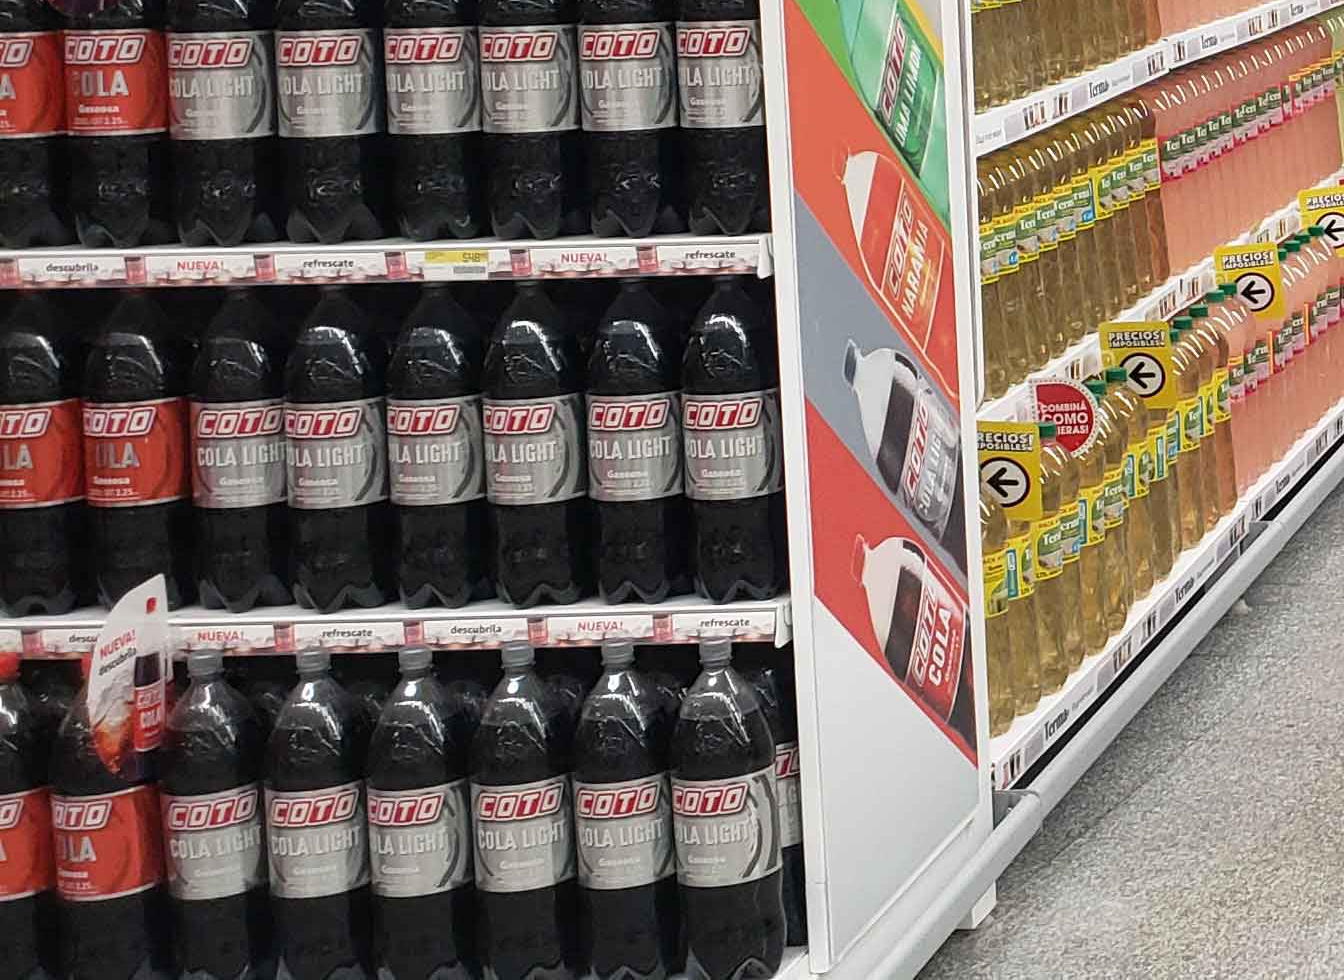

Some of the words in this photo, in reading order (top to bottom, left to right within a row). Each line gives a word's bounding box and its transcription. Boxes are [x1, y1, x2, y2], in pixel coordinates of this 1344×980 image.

[64, 34, 148, 65] COTO
[168, 37, 254, 68] COTO
[279, 35, 364, 66] COTO
[581, 28, 660, 60] COTO
[619, 65, 663, 90] LIGHT
[879, 24, 906, 126] COTO
[45, 262, 99, 274] descubrila
[176, 259, 225, 272] NUEVA!
[303, 258, 355, 270] refrescate
[561, 251, 608, 265] NUEVA!
[685, 250, 737, 262] refrescate
[901, 218, 929, 321] NARANJA
[198, 406, 286, 437] COTO
[591, 400, 669, 431] COTO
[1041, 412, 1089, 425] COMO
[628, 434, 672, 458] LIGHT
[903, 399, 930, 502] COTO
[98, 628, 137, 659] NUEVA!
[197, 630, 245, 643] NUEVA!
[322, 627, 374, 639] refrescate
[450, 623, 502, 637] descubrila
[577, 619, 624, 633] NUEVA!
[699, 616, 751, 631] refrescate
[928, 603, 952, 687] COLA
[168, 790, 259, 828] COTO
[271, 788, 358, 827] COTO
[478, 783, 565, 824] COTO
[478, 825, 517, 851] COLA
